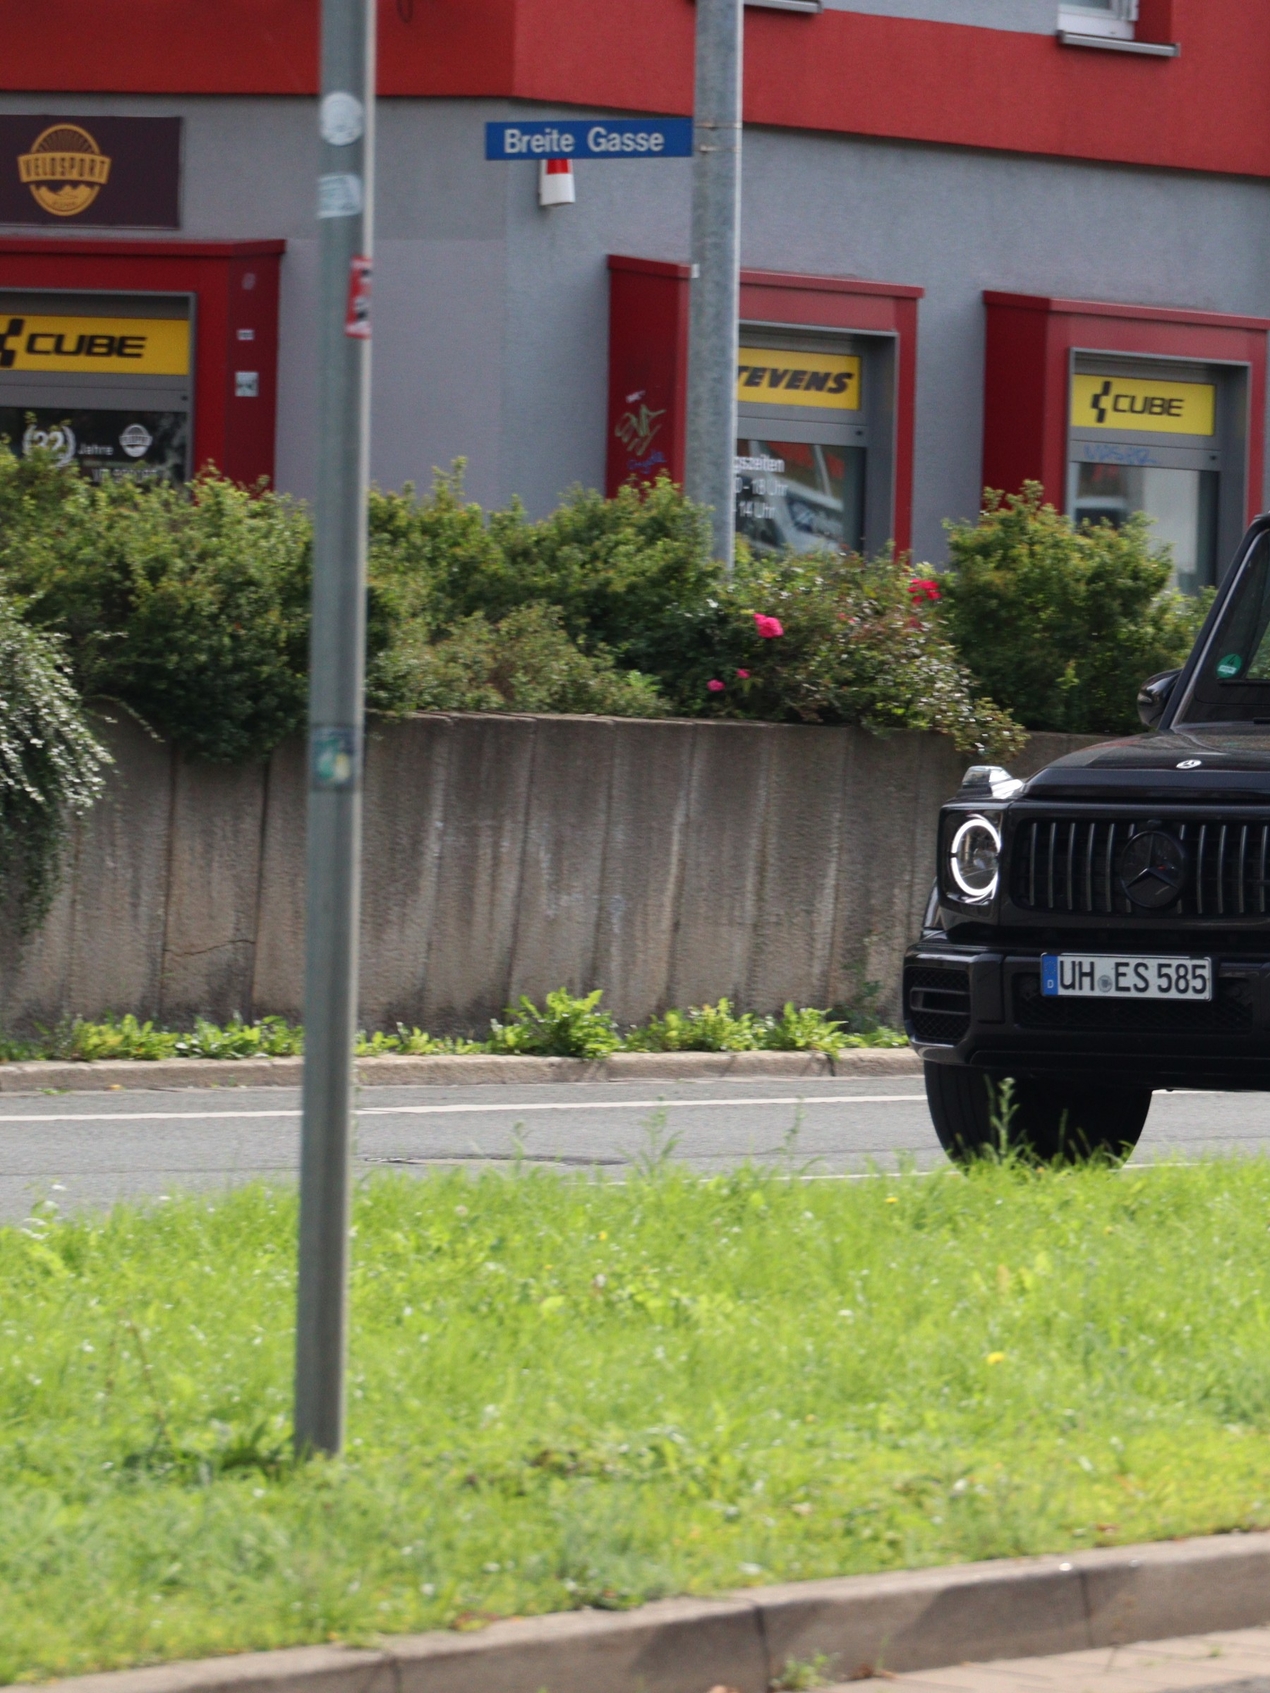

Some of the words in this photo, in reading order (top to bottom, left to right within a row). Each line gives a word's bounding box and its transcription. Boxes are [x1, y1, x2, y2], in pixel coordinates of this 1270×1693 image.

[504, 128, 575, 153] Breite
[587, 126, 665, 152] Gasse
[26, 333, 148, 358] CUBE
[1113, 394, 1185, 416] CUBE
[1059, 960, 1095, 991] UH
[1114, 961, 1150, 993] ES
[1157, 963, 1207, 994] 585
